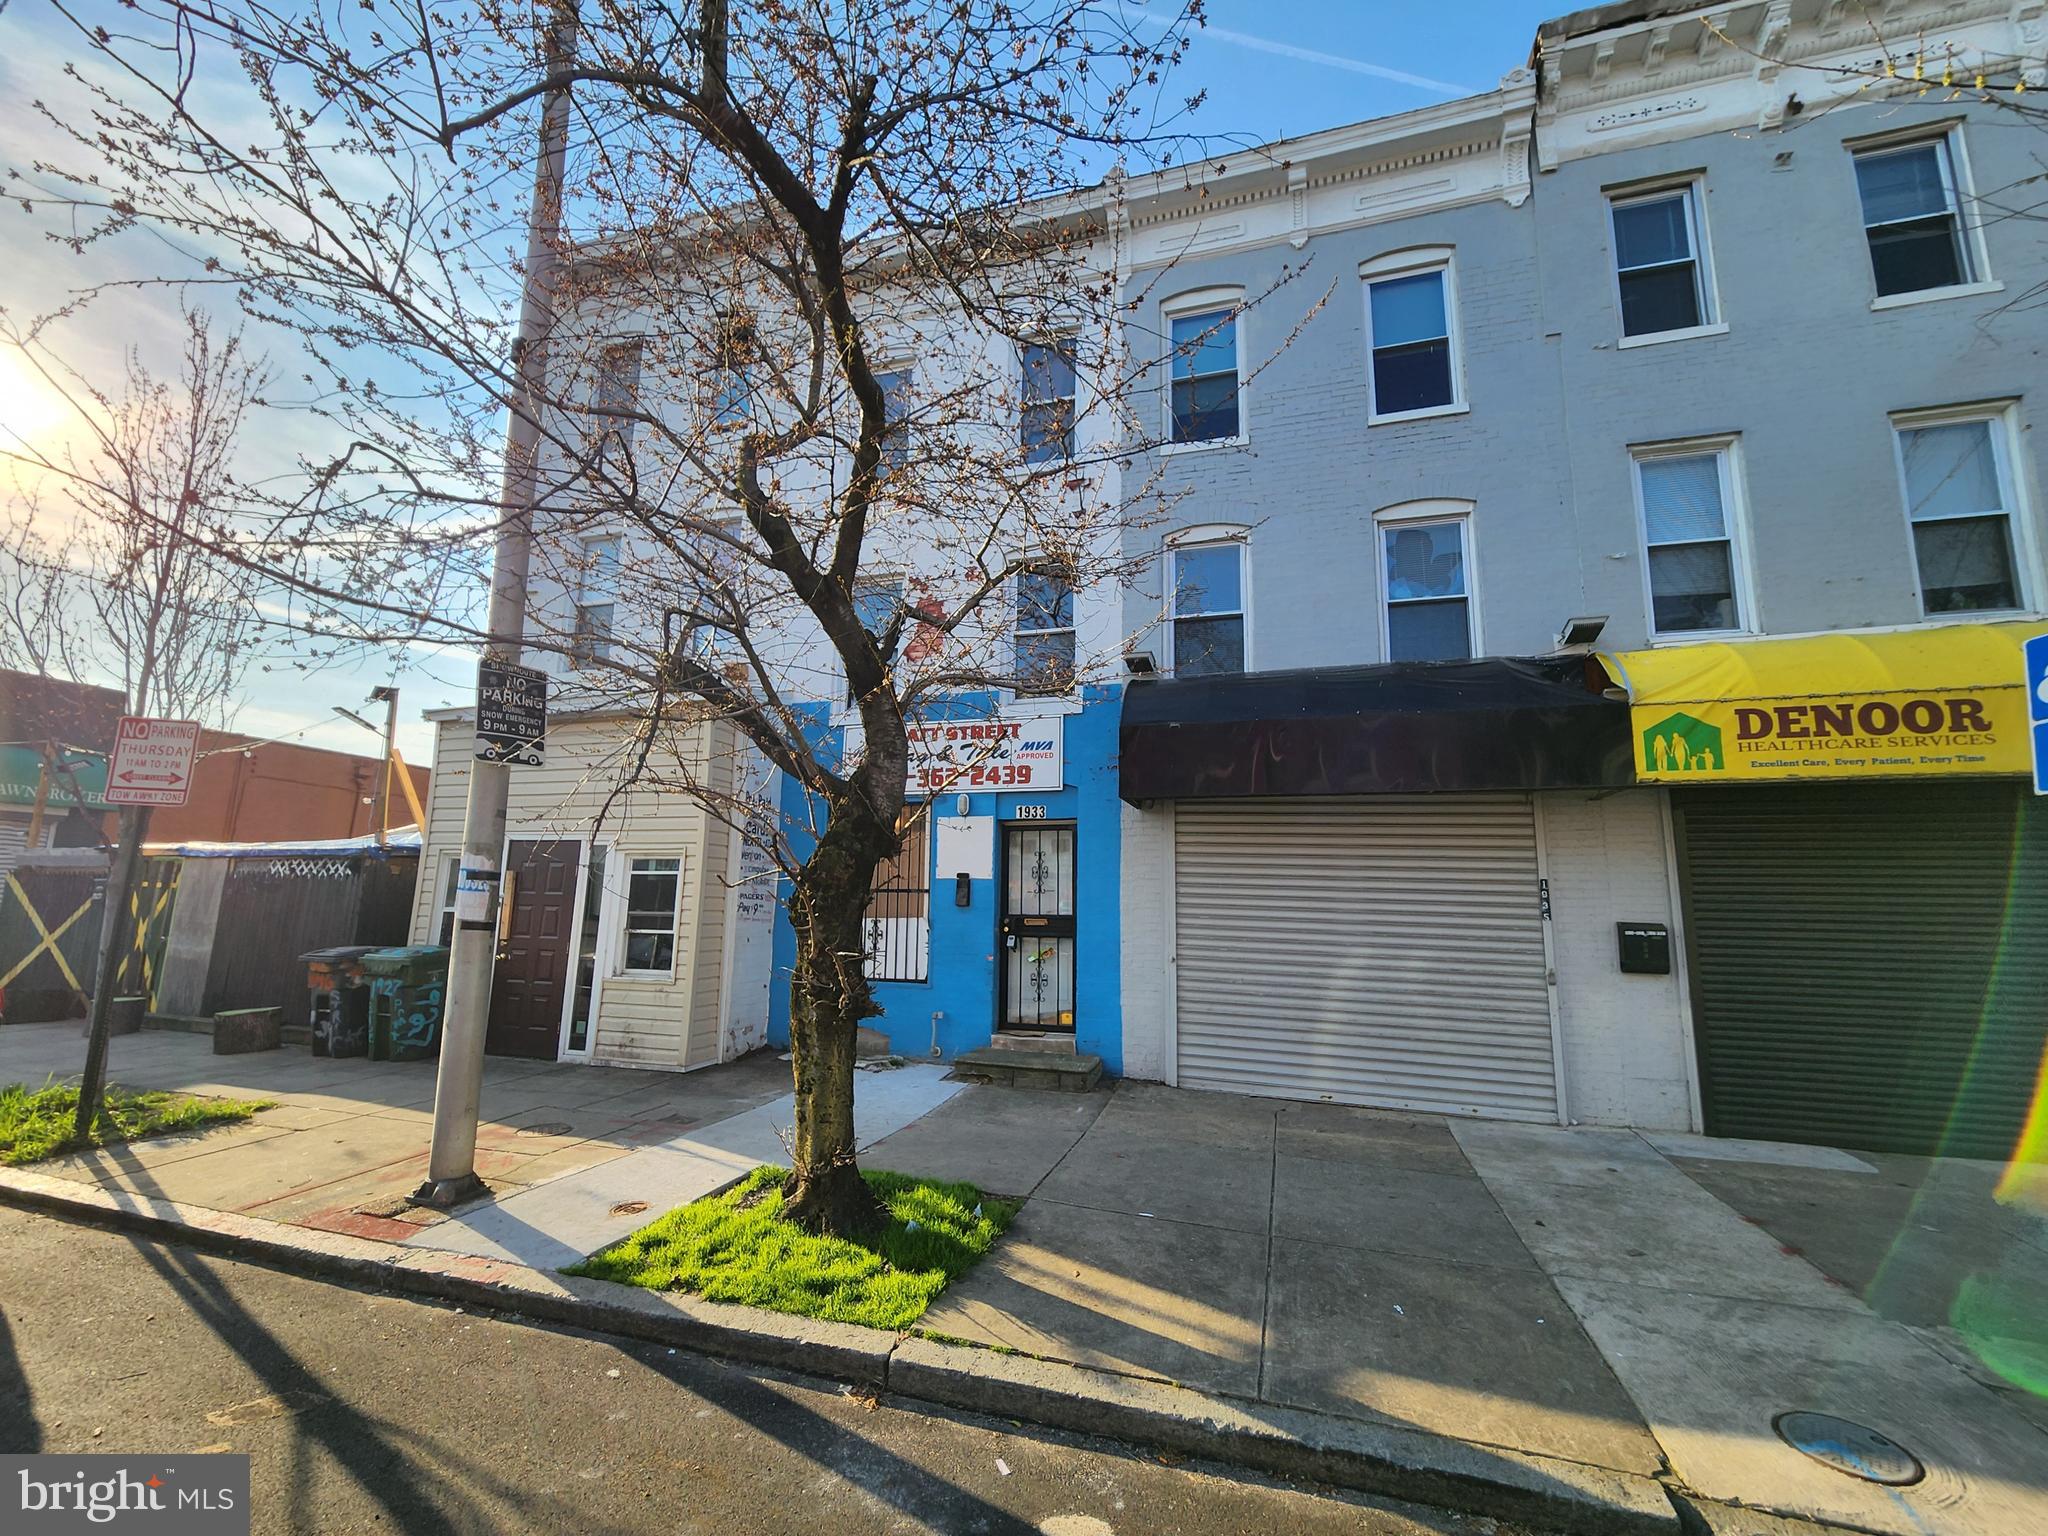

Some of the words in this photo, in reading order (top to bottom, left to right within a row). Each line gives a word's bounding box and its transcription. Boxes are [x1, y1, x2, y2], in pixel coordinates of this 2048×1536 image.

[506, 676, 527, 690] NO
[482, 689, 543, 709] PARKING
[481, 710, 503, 719] SNOW
[505, 714, 542, 726] EMERGENCY
[1734, 699, 1992, 740] DENOOR
[123, 721, 149, 738] NO
[150, 725, 195, 739] PARKING
[483, 719, 491, 730] 9
[493, 723, 507, 732] PM
[519, 724, 526, 735] 9
[527, 728, 540, 736] AM
[905, 727, 938, 742] ATT
[946, 723, 1021, 741] STREET
[121, 743, 192, 757] THURSDAY
[1020, 741, 1054, 751] MVA
[1738, 737, 1882, 752] HEALTHCARE
[1887, 733, 1997, 748] SERVICES
[907, 750, 929, 768] ag
[960, 742, 1011, 761] Tile
[1016, 752, 1054, 760] APPROVED
[1751, 759, 1800, 768] Excellent
[1802, 758, 1830, 767] Care,
[1835, 758, 1866, 767] Every
[1872, 756, 1915, 765] Patient,
[1920, 755, 1953, 765] Every
[1955, 754, 1986, 763] Time
[150, 760, 161, 768] TO
[906, 765, 1032, 787] -362-2439
[111, 790, 131, 799] TOW
[133, 791, 157, 800] AWAY
[160, 792, 184, 801] ZONE
[1018, 806, 1046, 818] 1933
[1541, 880, 1550, 921] 1935
